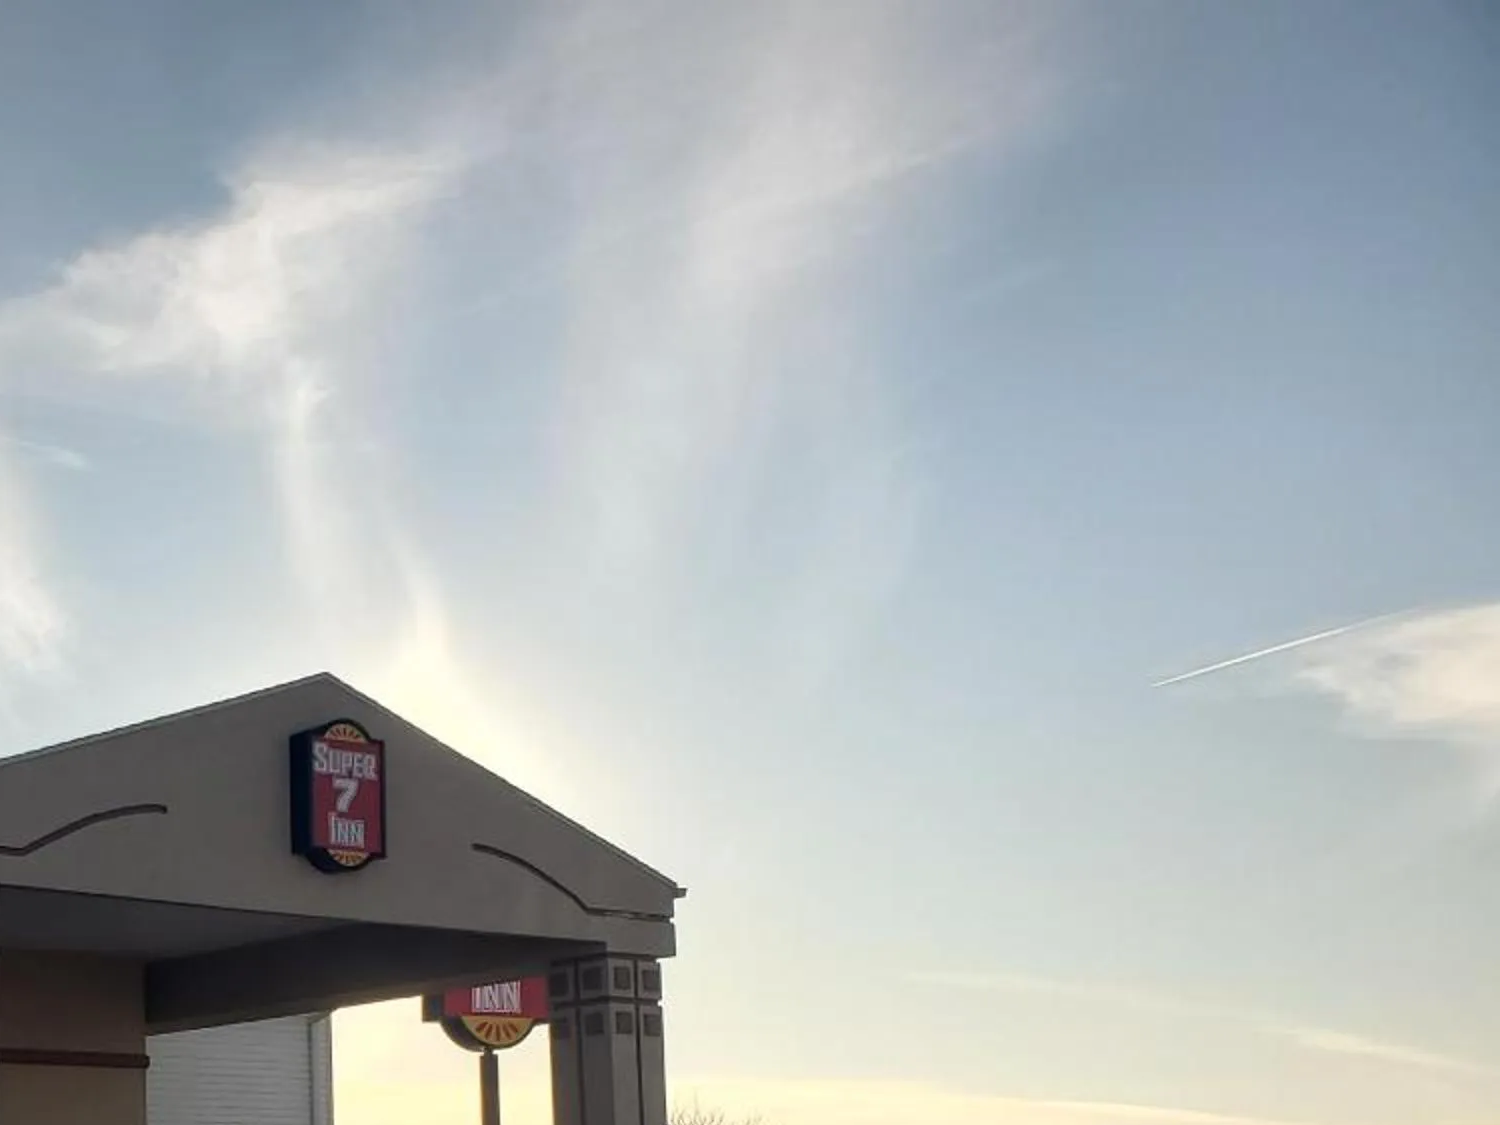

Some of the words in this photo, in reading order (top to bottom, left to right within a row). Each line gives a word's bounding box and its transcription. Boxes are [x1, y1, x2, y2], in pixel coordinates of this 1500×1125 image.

[313, 742, 377, 780] SUPER
[333, 778, 359, 813] 7
[328, 812, 365, 848] INN
[471, 980, 521, 1013] INN
